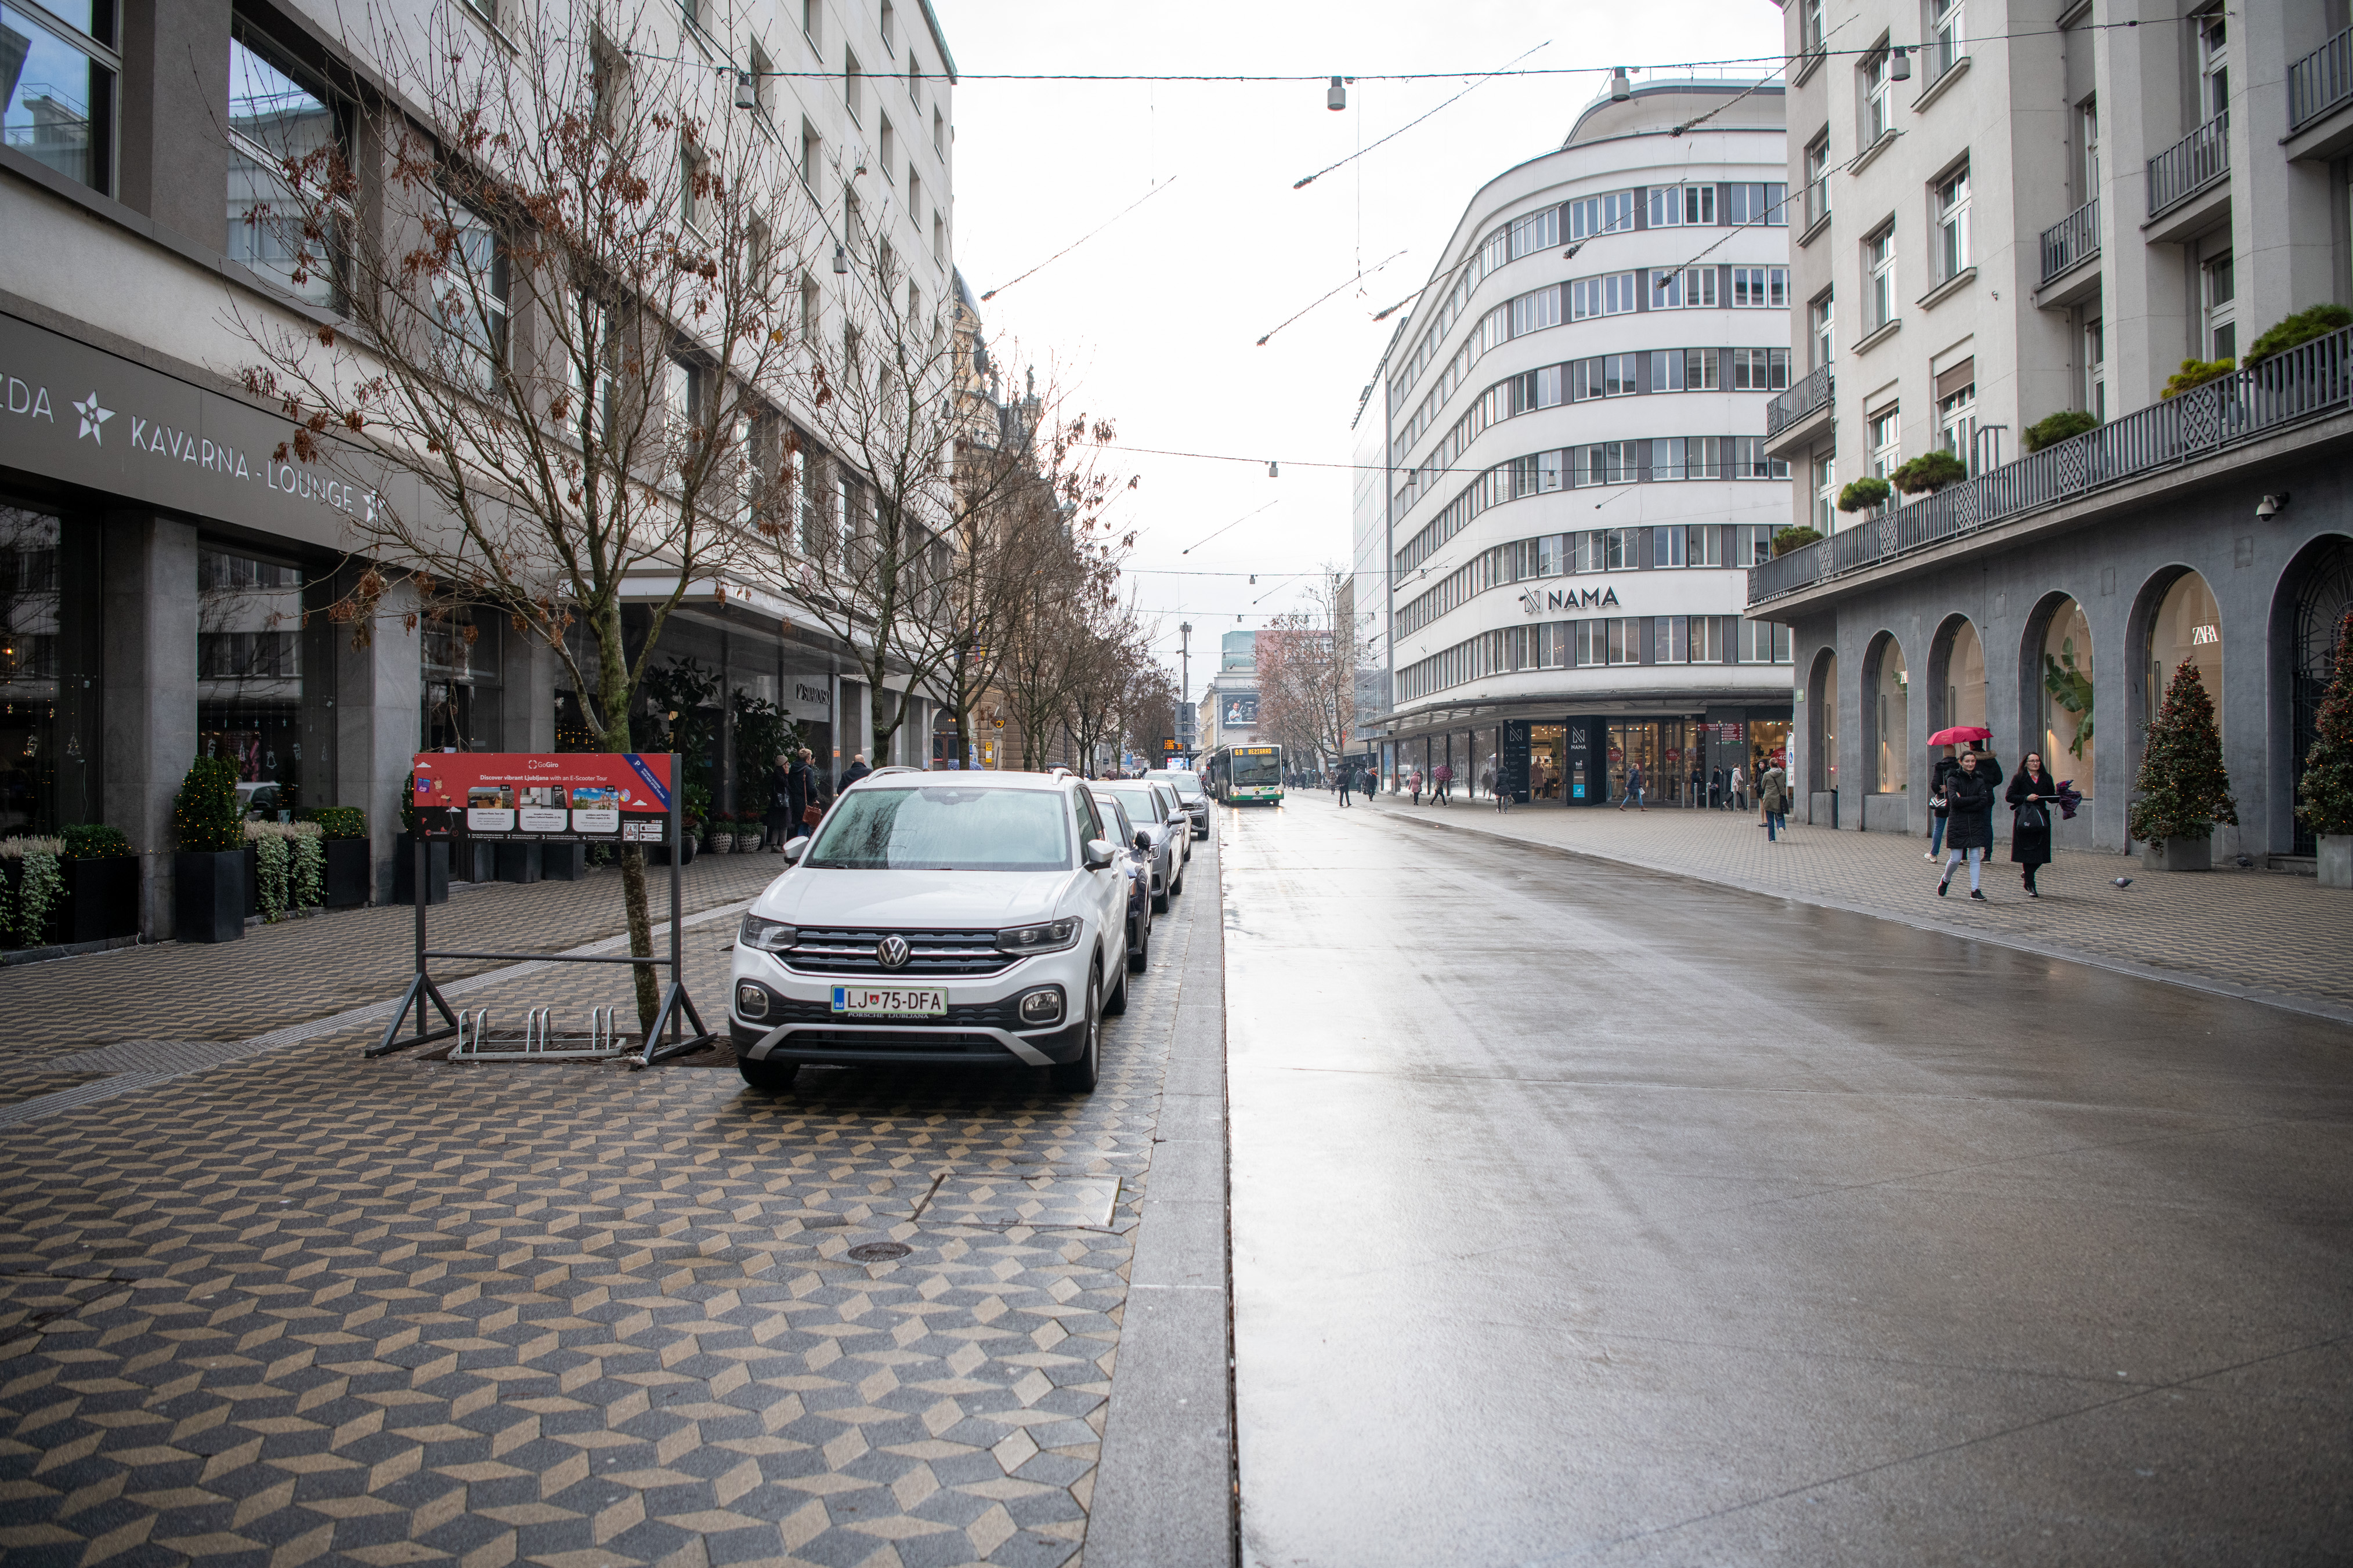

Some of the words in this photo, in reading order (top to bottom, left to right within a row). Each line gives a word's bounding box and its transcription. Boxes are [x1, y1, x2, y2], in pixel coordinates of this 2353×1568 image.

[132, 415, 251, 480] KAVARNA
[268, 459, 353, 512] LOUNGE
[1548, 585, 1620, 610] NAMA
[2192, 624, 2219, 645] ZARA
[804, 685, 830, 705] SWAROVSKI
[848, 991, 868, 1008] LJ
[881, 991, 941, 1010] 75-DFA
